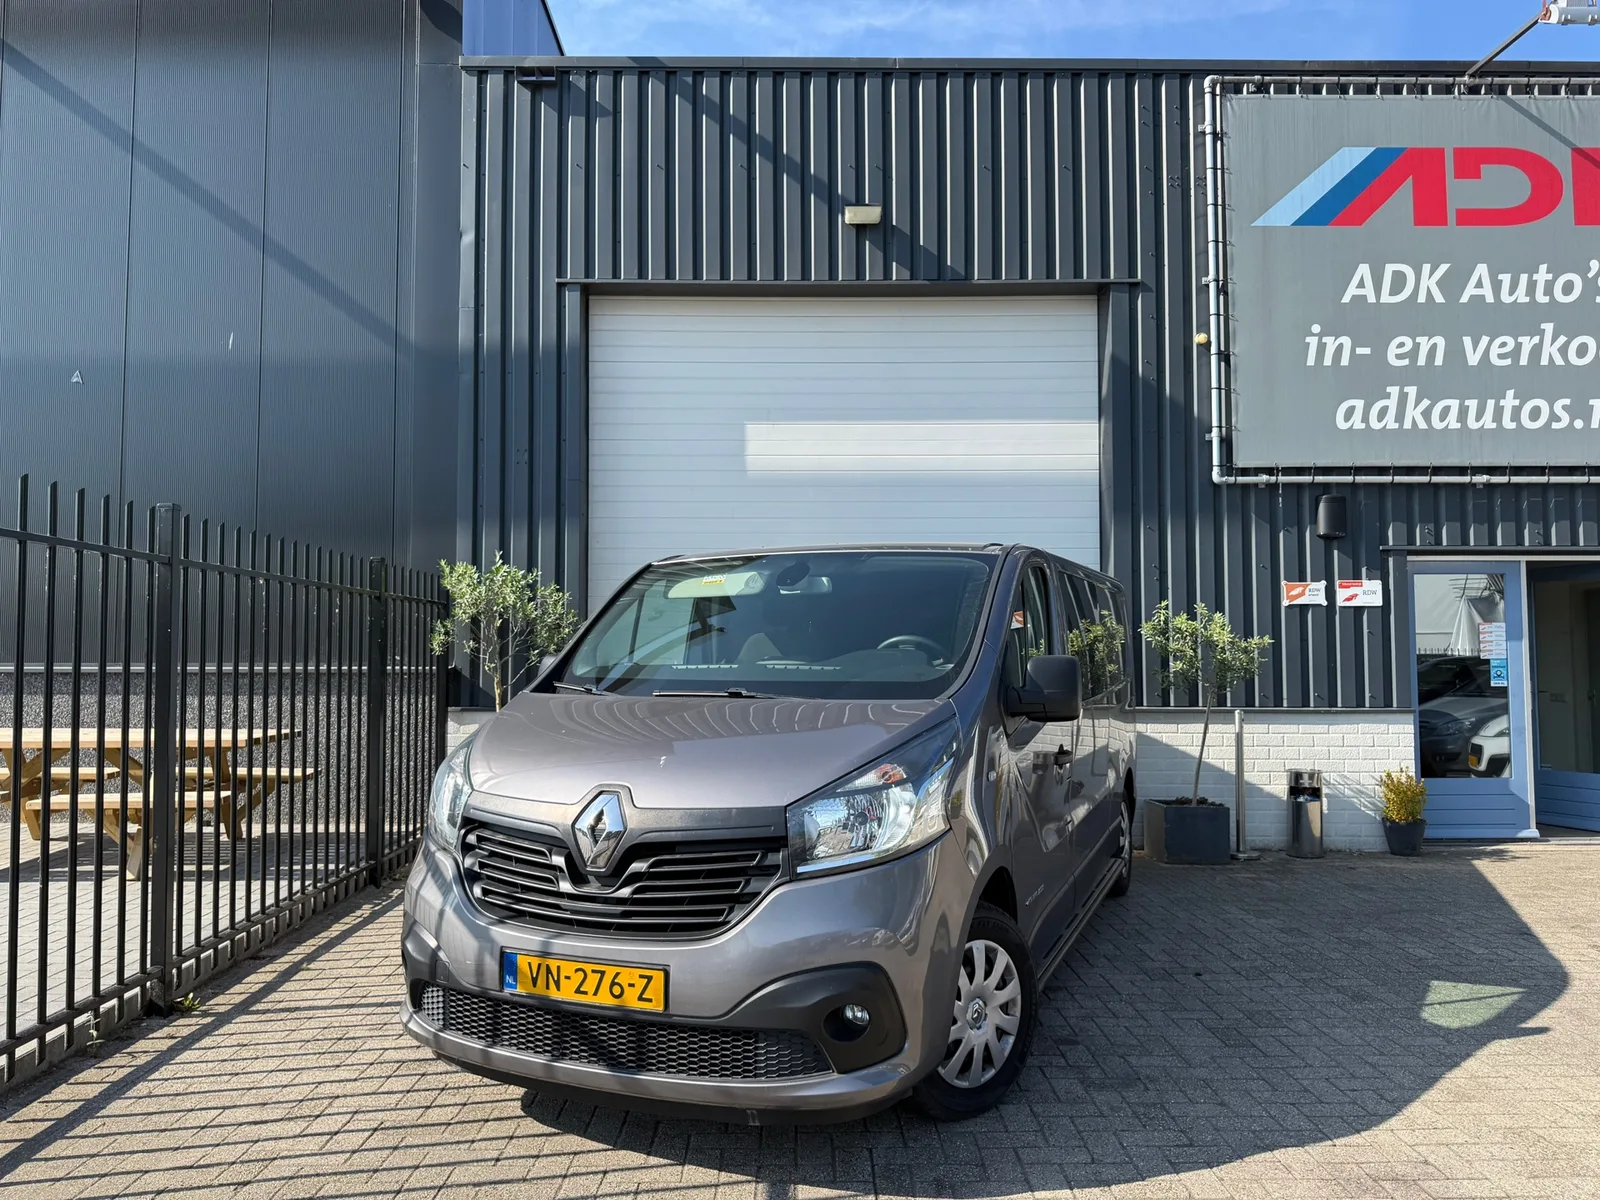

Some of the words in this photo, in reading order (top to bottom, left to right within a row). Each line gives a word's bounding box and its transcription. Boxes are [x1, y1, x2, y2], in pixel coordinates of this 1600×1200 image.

[1341, 263, 1452, 303] ADK
[1459, 259, 1600, 304] Auto'
[1305, 324, 1371, 366] in-
[1387, 334, 1446, 366] en
[1463, 323, 1600, 366] verko
[506, 975, 516, 985] NL
[527, 961, 653, 1003] VN-276-Z
